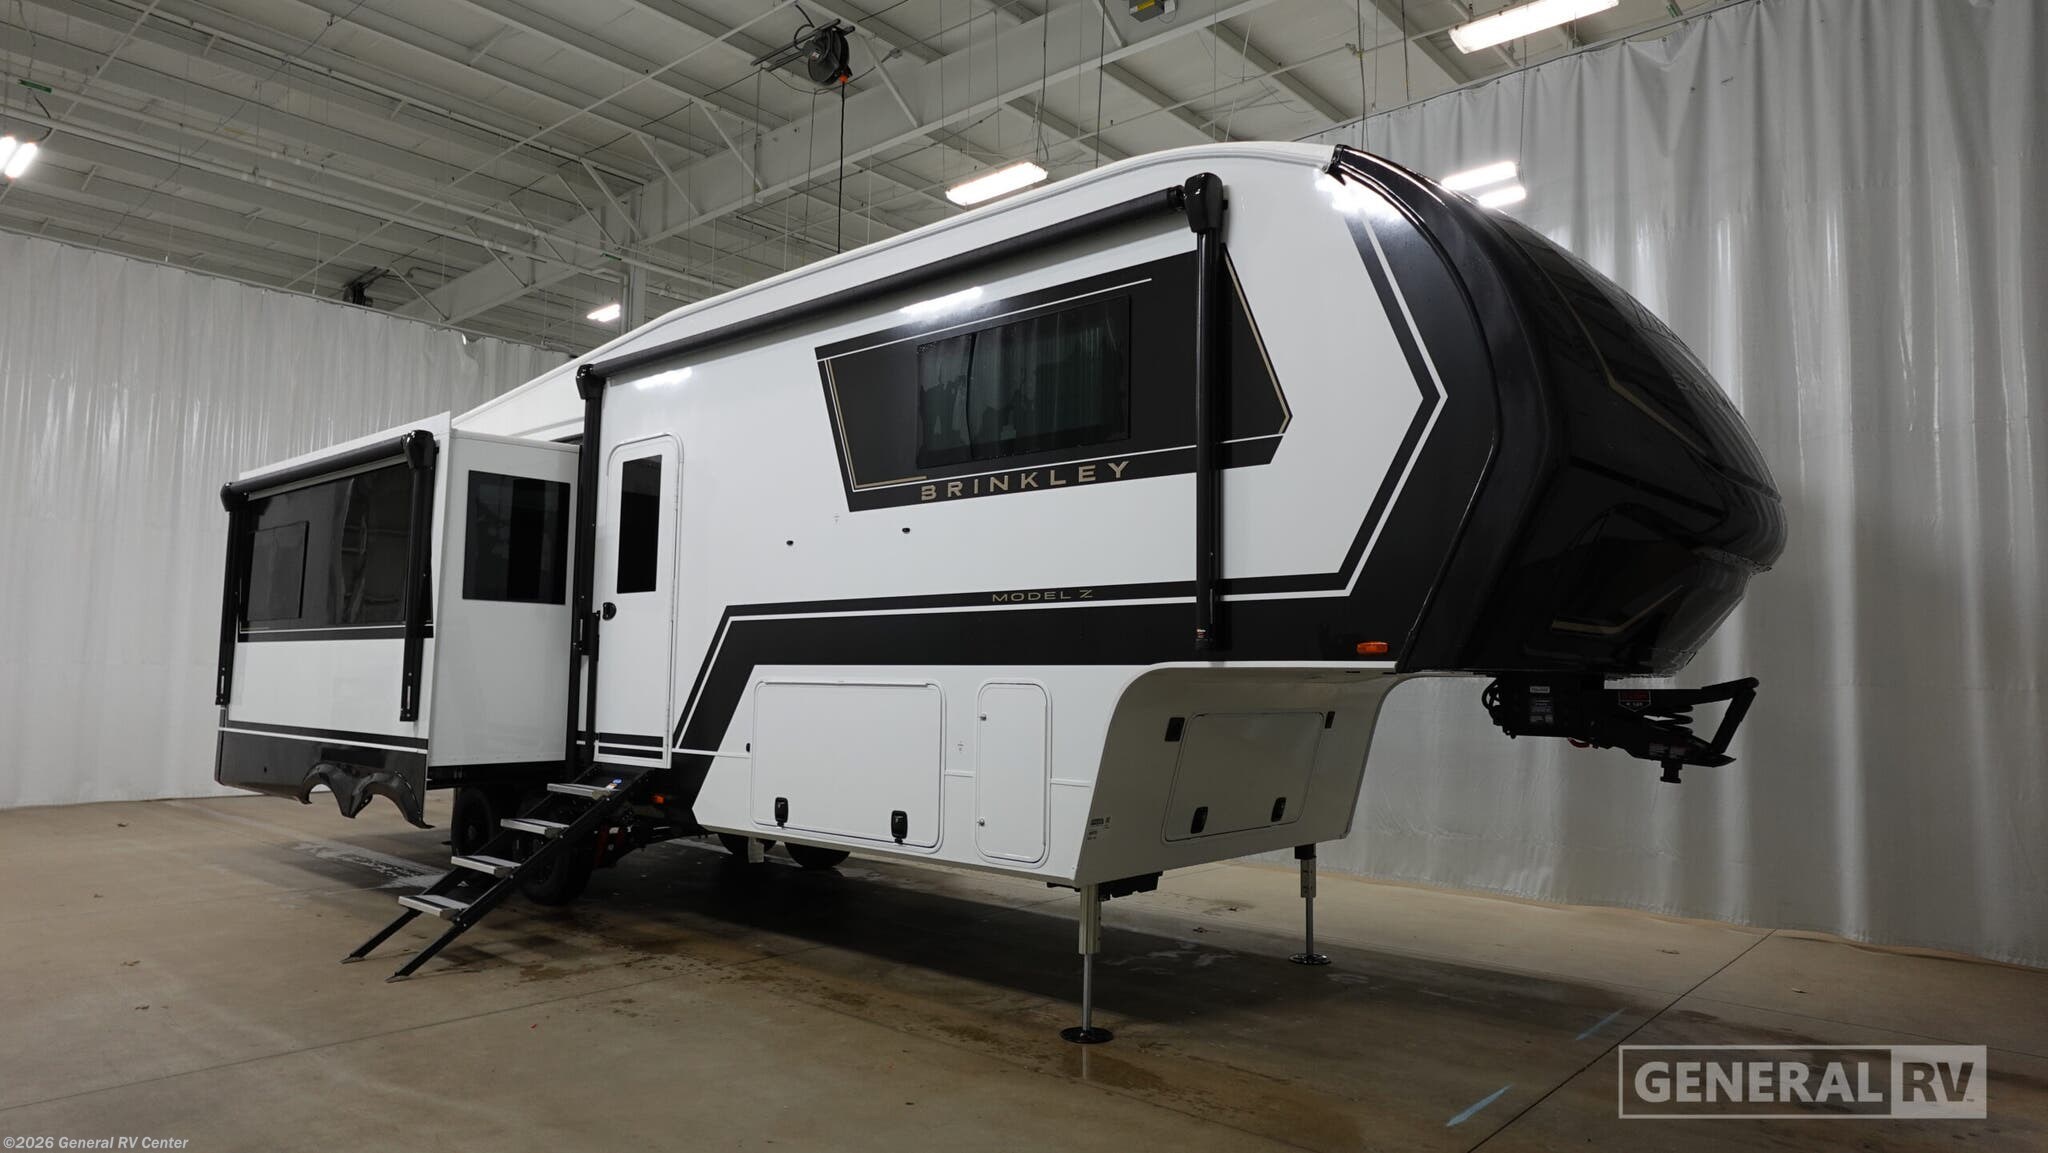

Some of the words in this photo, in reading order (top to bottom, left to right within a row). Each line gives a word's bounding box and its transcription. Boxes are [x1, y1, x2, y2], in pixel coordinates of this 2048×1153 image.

[921, 461, 1130, 501] BRINKLEY
[992, 591, 1072, 603] MODEL
[1079, 589, 1093, 599] Z
